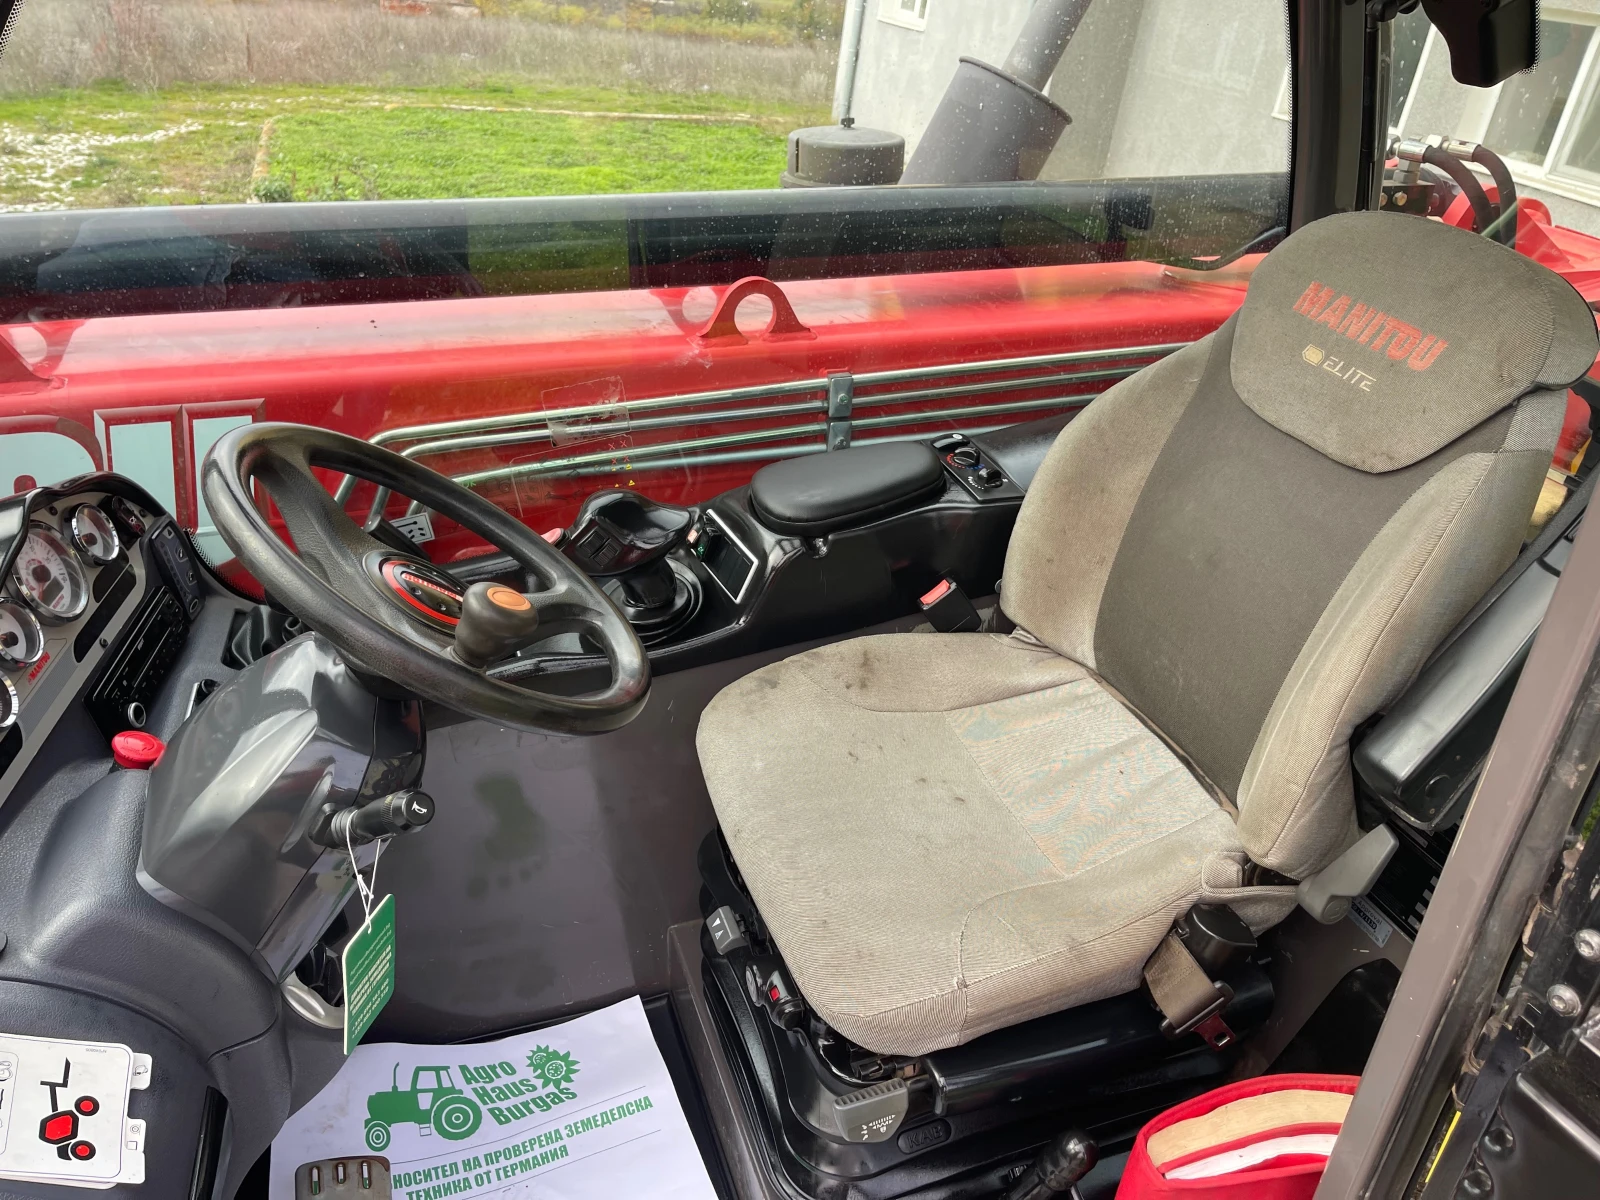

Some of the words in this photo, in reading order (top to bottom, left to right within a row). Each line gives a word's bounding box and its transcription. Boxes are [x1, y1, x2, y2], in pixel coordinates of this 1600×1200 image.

[1292, 280, 1449, 373] MANITOU
[1323, 357, 1377, 391] ELITE
[458, 1061, 517, 1086] Agro
[471, 1078, 538, 1106] Haus
[487, 1087, 578, 1126] Burgas
[391, 1161, 460, 1190] НОСИТЕЛ
[461, 1155, 483, 1173] НА
[483, 1128, 564, 1167] ПРОВЕРЕНА
[564, 1095, 654, 1139] ЗЕМЕДЕЛСКА
[908, 1126, 943, 1148] KAB
[405, 1176, 473, 1200] ТЕХНИКА
[474, 1169, 492, 1188] ОТ
[495, 1144, 570, 1182] ГЕРМАНИЯ
